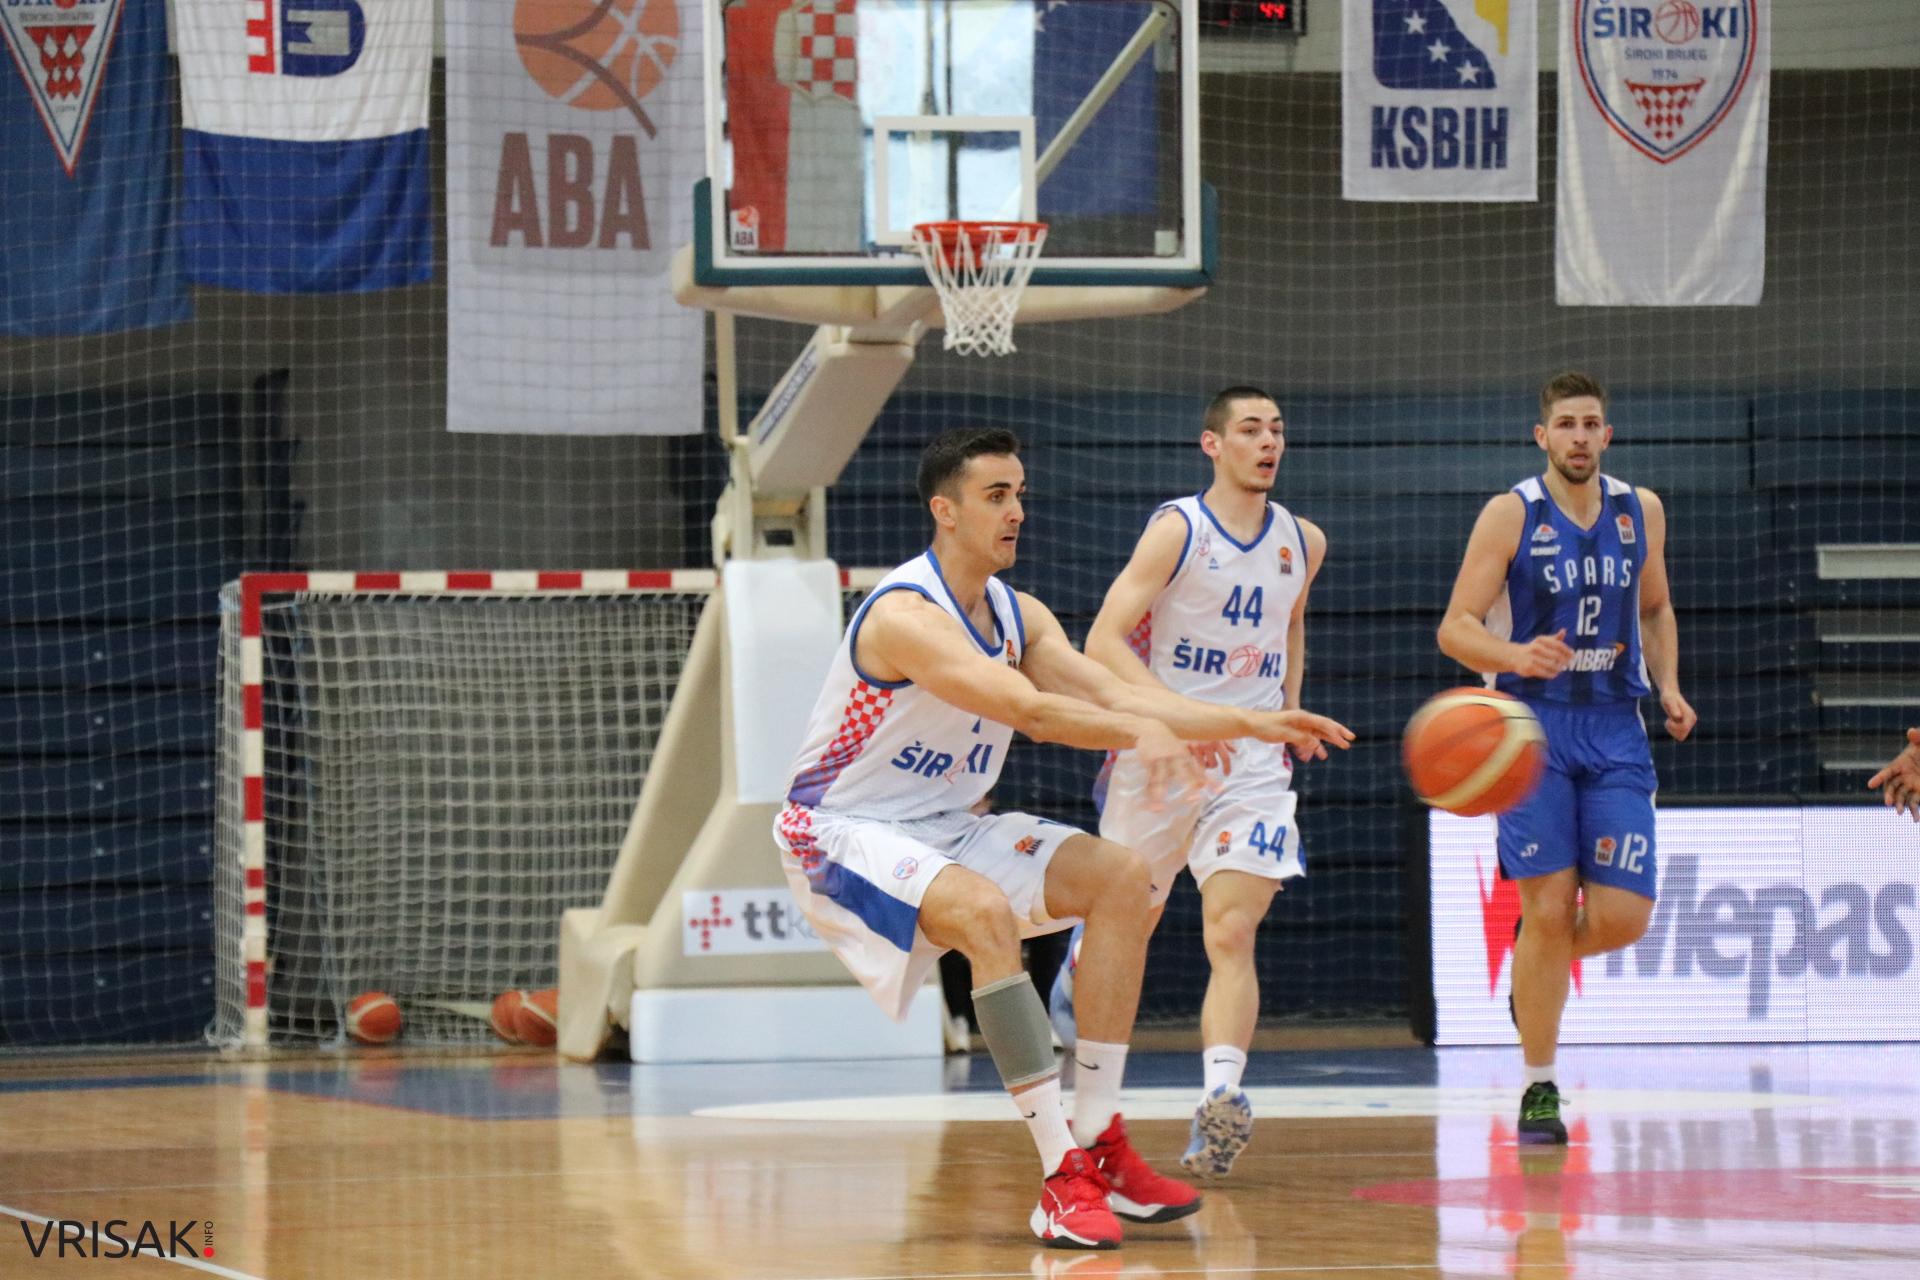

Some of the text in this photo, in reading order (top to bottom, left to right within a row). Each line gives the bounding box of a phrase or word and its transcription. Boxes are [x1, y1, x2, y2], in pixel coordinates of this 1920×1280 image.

[1371, 106, 1508, 169] KSBIH
[489, 132, 652, 249] ABA
[735, 231, 754, 245] ABA
[1543, 555, 1633, 594] SPARS
[1222, 585, 1263, 628] 44
[1576, 595, 1602, 636] 12
[891, 740, 994, 779] ŠIRKI
[1248, 821, 1286, 862] 44
[1619, 833, 1648, 875] 12
